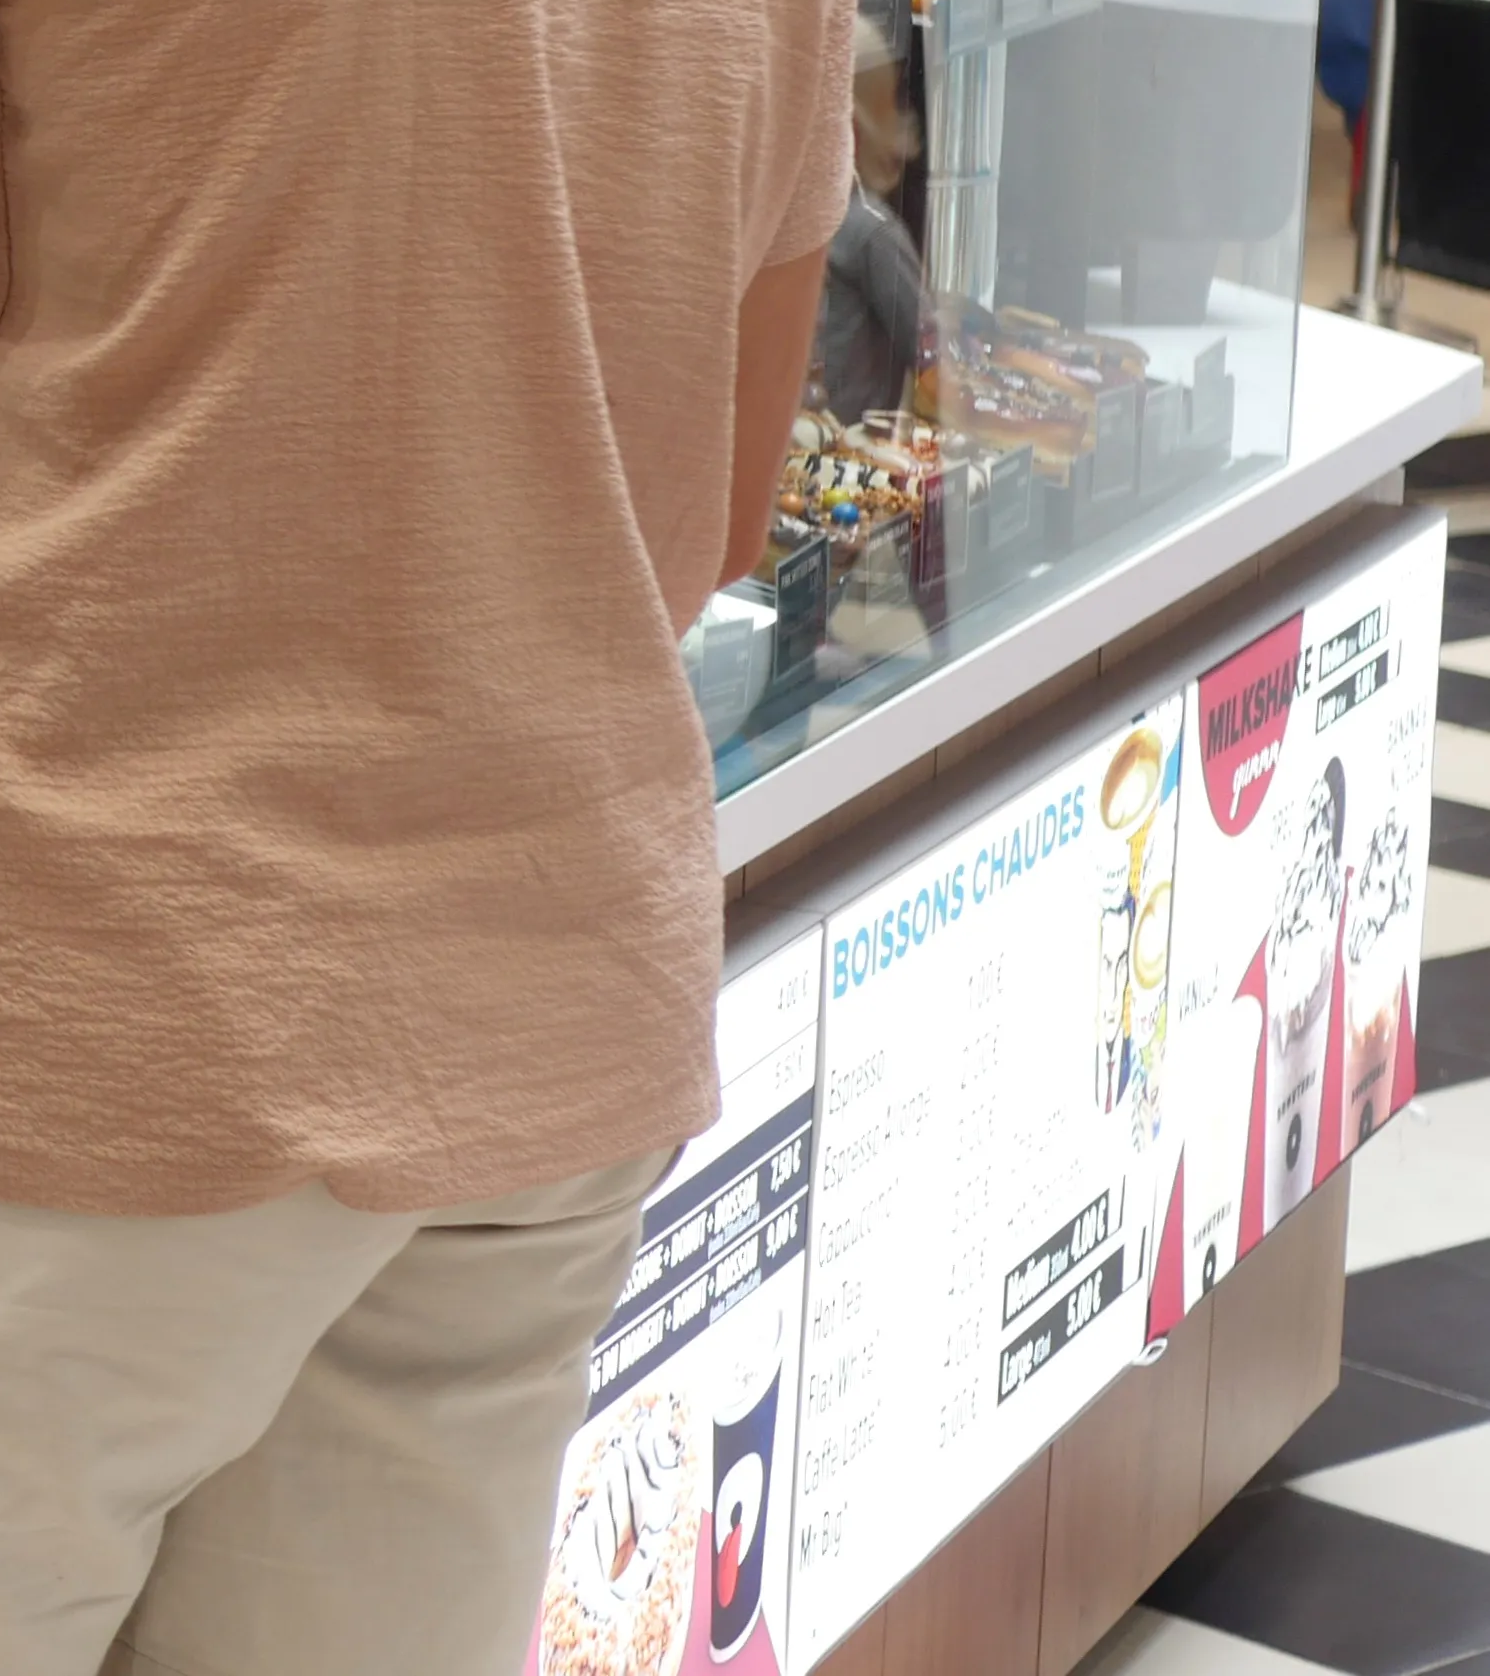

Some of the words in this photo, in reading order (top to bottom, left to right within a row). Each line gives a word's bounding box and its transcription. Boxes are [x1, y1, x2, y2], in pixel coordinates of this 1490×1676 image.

[1206, 644, 1313, 762] MILKSHAKE
[832, 864, 965, 1001] BOISSONS
[972, 784, 1086, 906] CHAUDES
